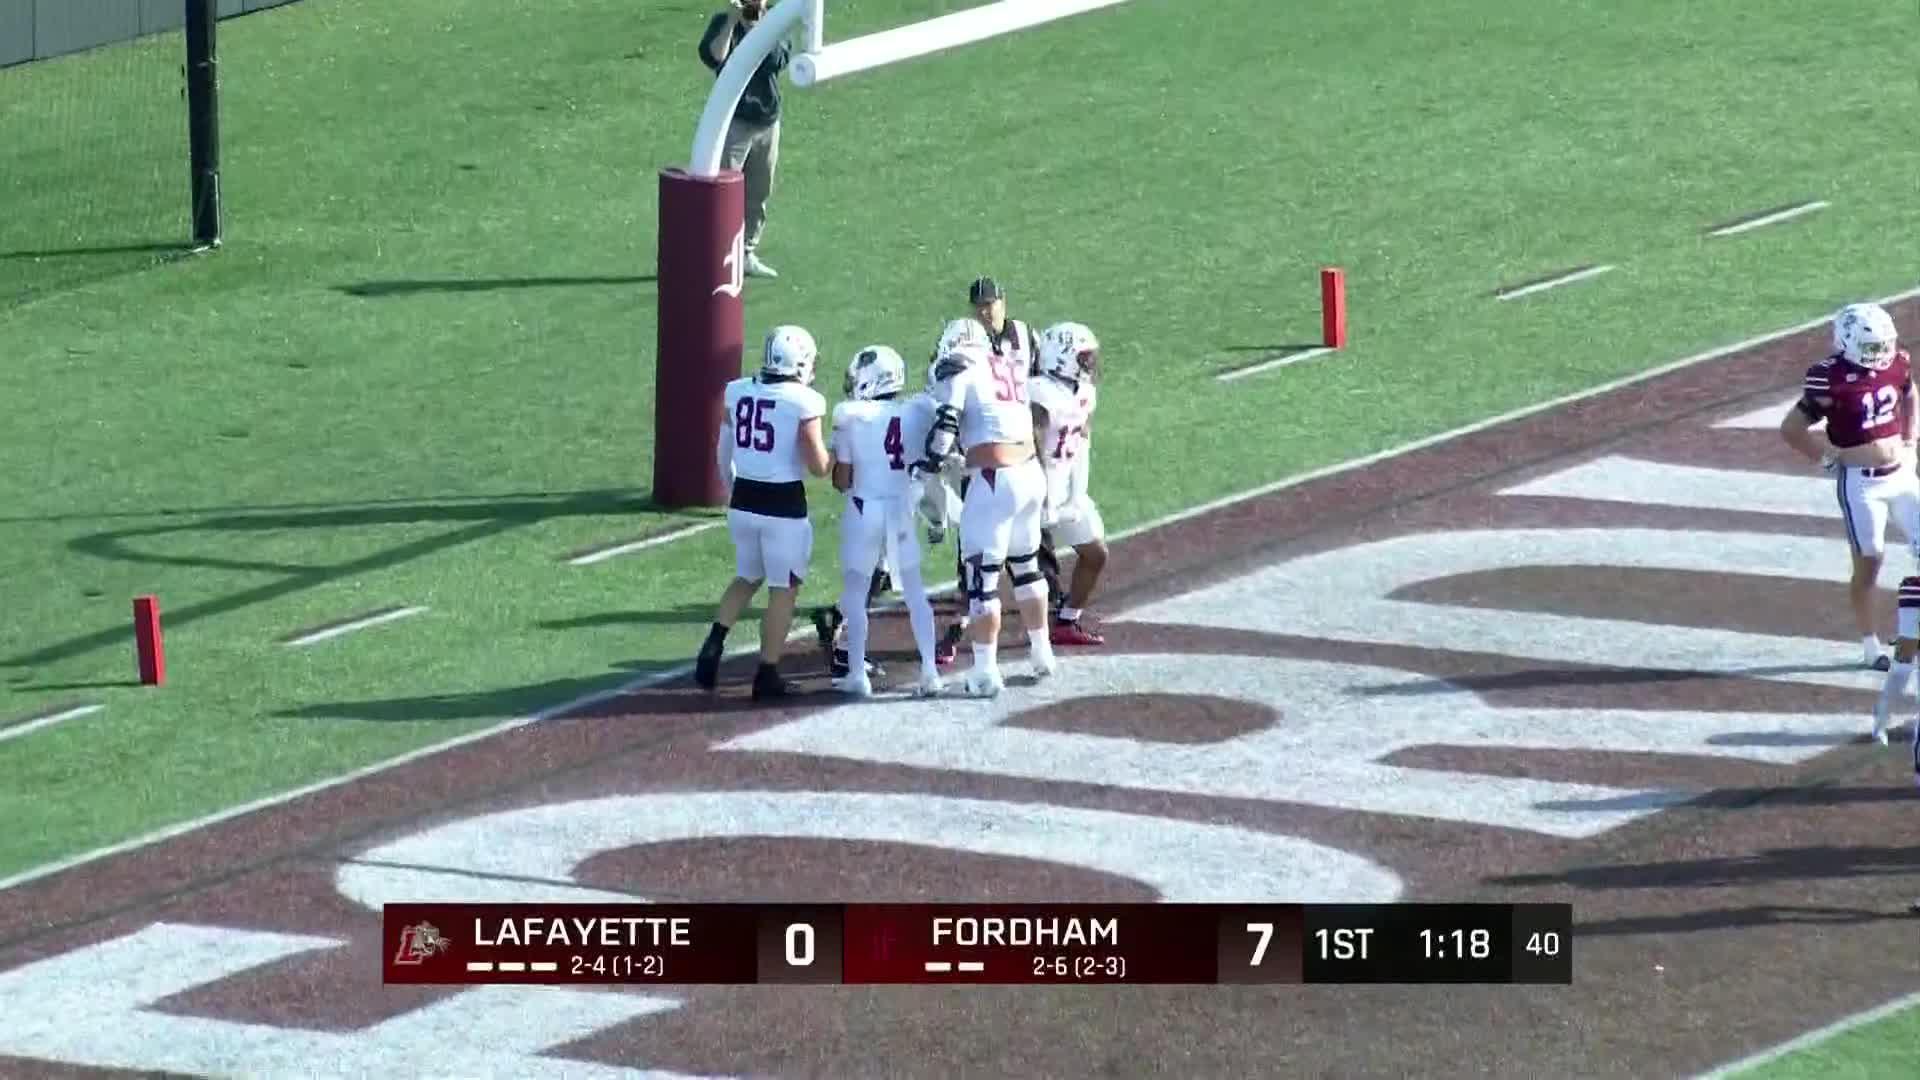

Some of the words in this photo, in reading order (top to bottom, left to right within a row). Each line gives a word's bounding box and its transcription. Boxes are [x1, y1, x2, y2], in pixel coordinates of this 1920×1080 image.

[735, 396, 776, 453] 85
[1861, 383, 1898, 430] 12
[883, 415, 906, 471] 4
